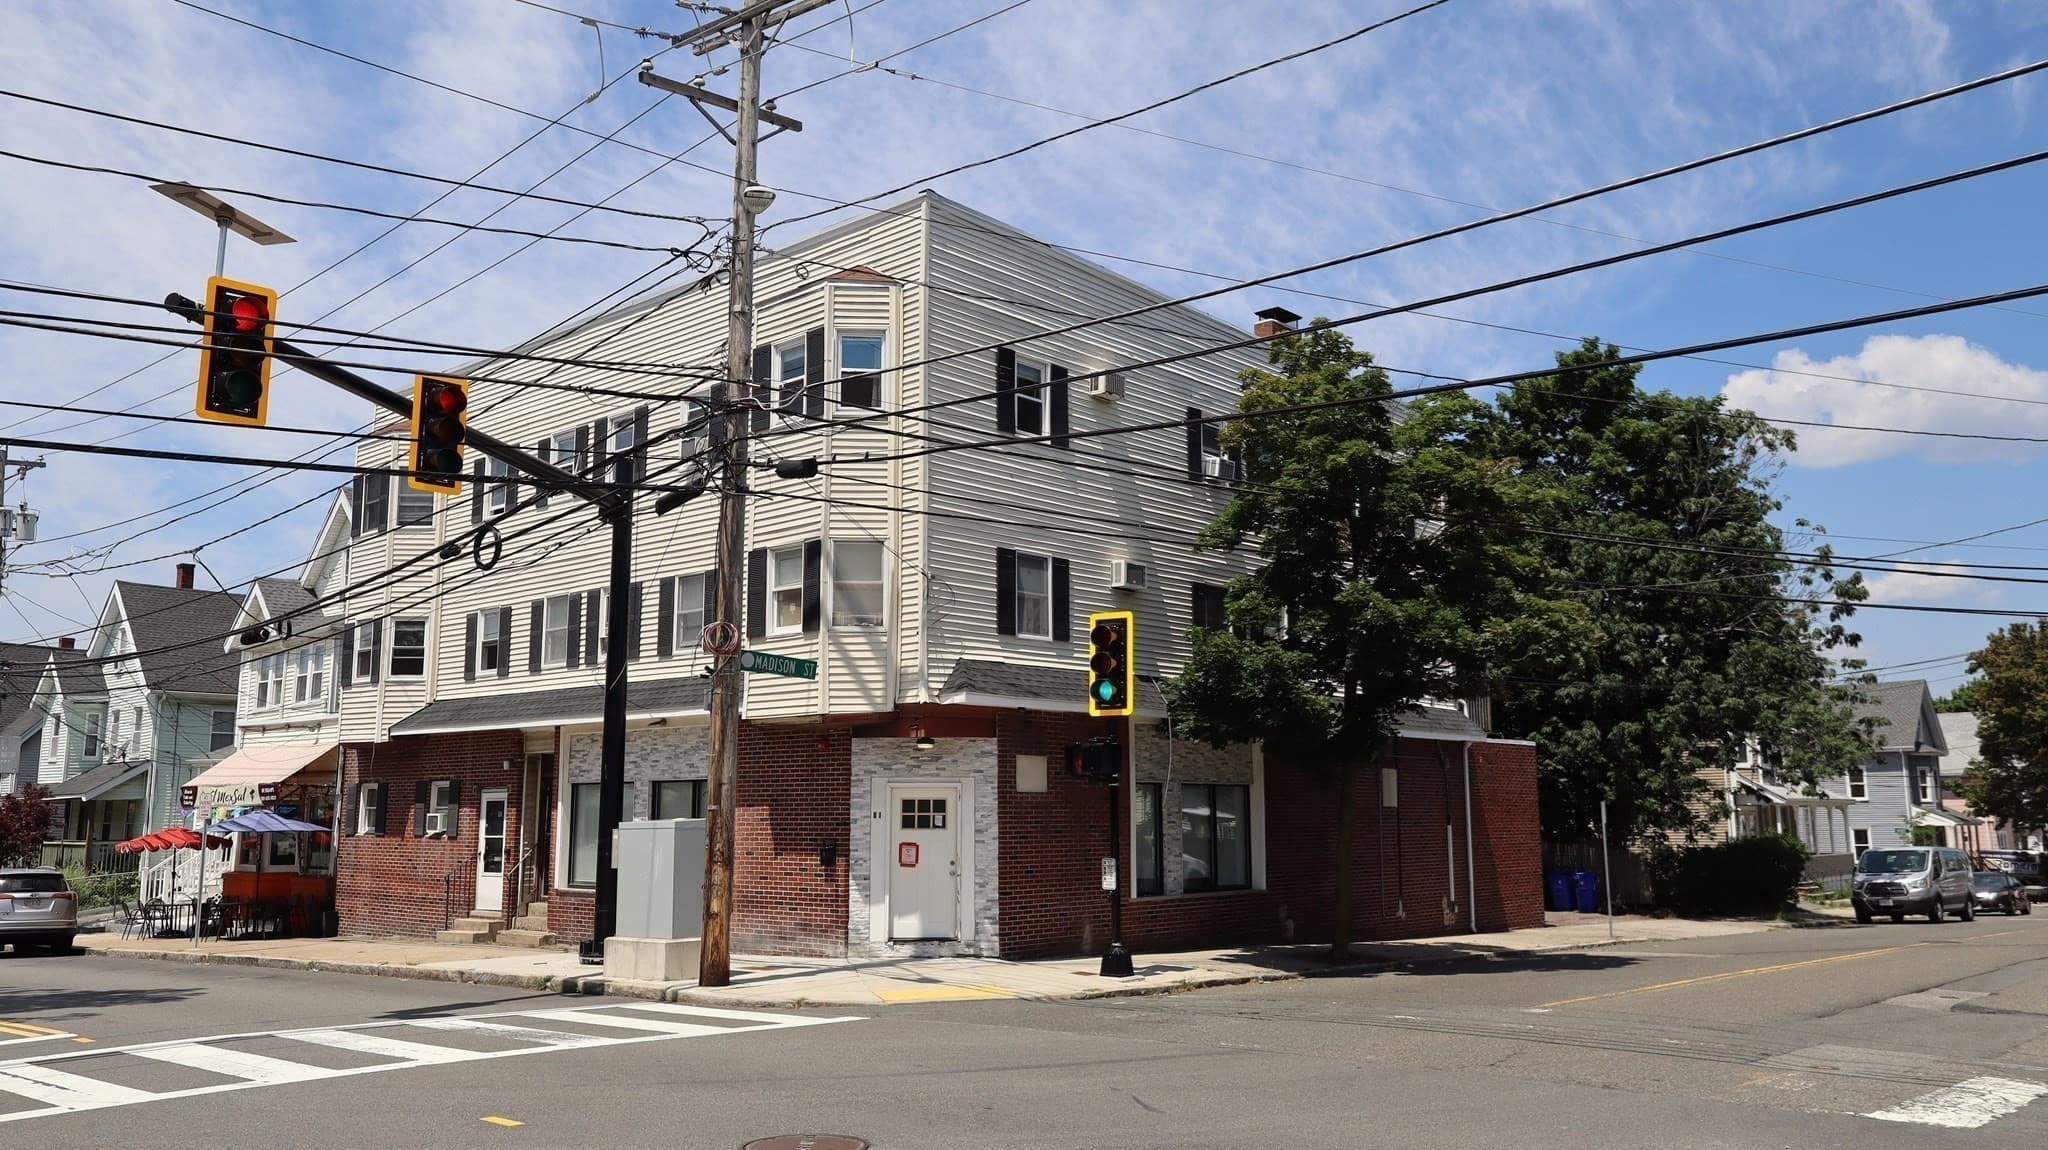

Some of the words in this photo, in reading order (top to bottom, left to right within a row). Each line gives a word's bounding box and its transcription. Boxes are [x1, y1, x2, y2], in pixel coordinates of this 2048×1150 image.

[755, 655, 796, 674] MADISON
[803, 662, 815, 677] ST
[217, 787, 247, 804] MexSal
